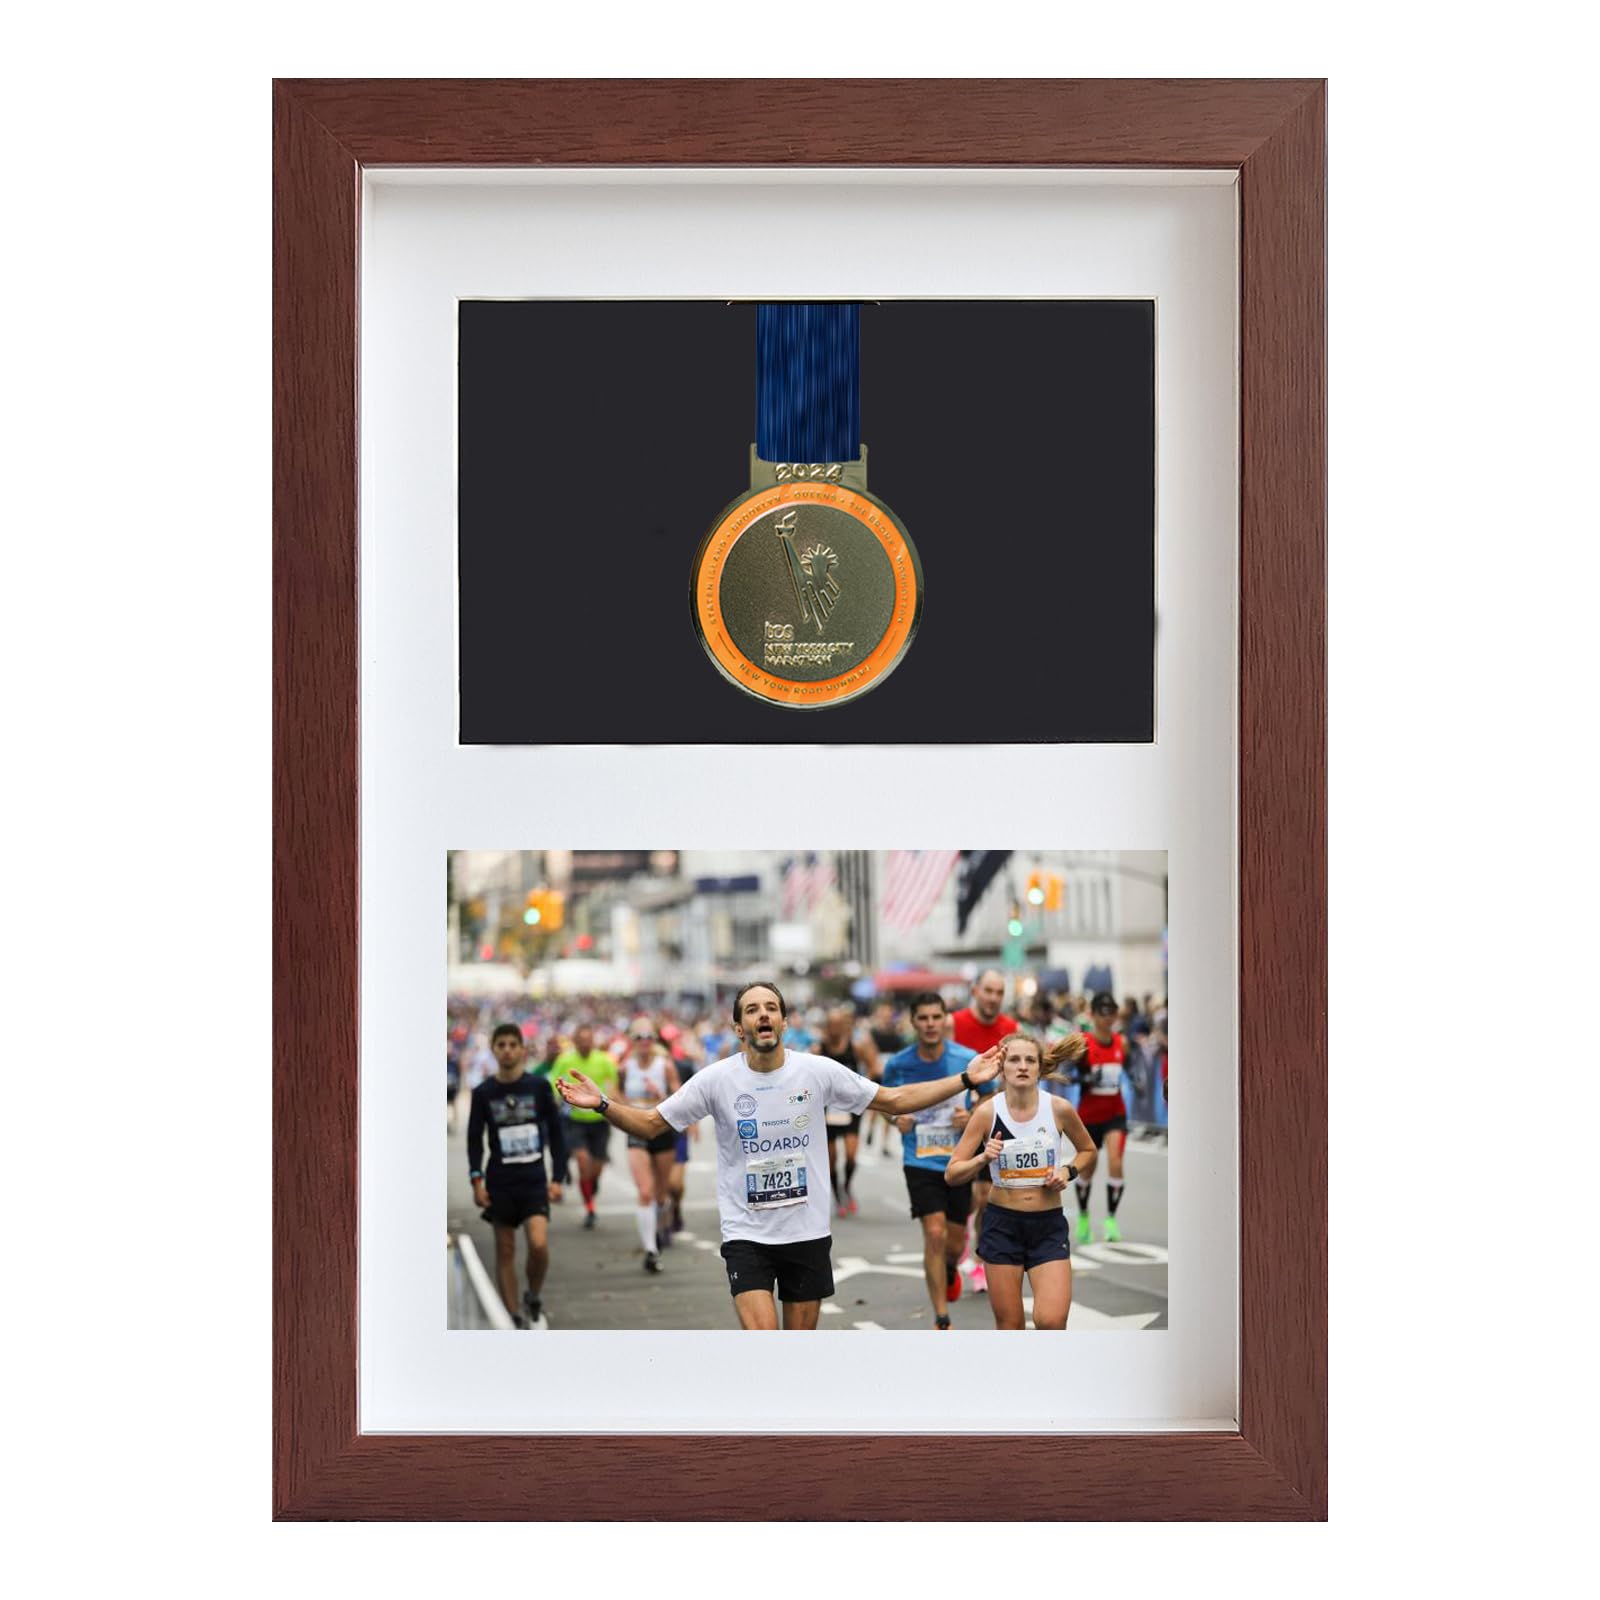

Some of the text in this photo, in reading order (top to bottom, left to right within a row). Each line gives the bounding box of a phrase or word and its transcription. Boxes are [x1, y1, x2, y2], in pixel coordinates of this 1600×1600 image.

[775, 463, 843, 482] 2024
[764, 654, 833, 667] MARATHON
[739, 663, 761, 681] NEW
[763, 678, 790, 693] YORK
[793, 687, 823, 695] ROAD
[742, 1134, 810, 1154] EDOARDO
[1016, 1152, 1039, 1169] 526
[762, 1171, 792, 1190] 7423
